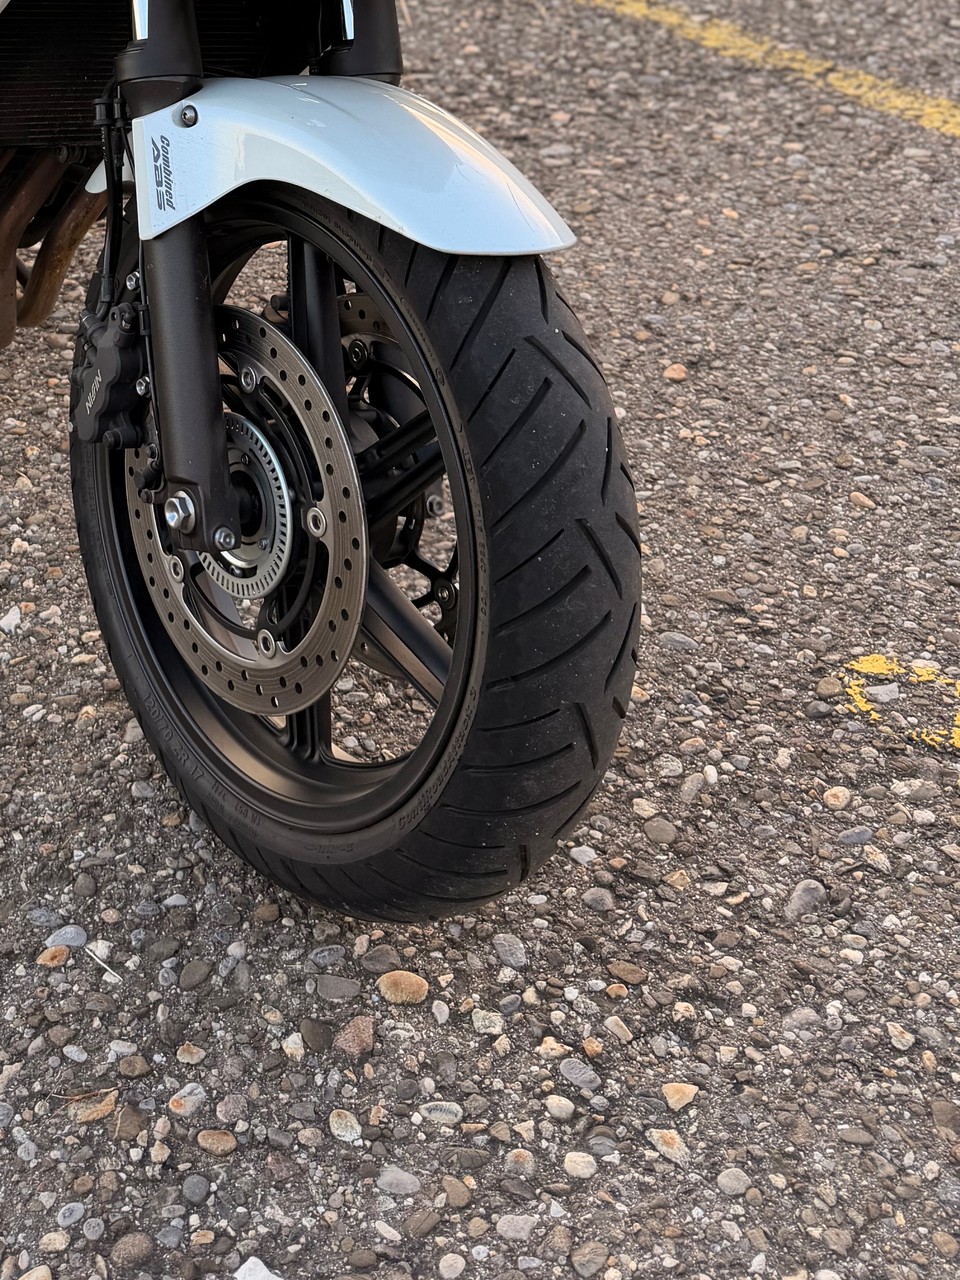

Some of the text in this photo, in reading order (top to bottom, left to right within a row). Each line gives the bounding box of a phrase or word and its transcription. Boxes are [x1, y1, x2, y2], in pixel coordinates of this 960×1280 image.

[150, 136, 166, 212] ABS
[160, 134, 176, 211] Combined
[142, 694, 174, 742] 120/70
[171, 744, 192, 767] ZR
[189, 765, 206, 783] 17
